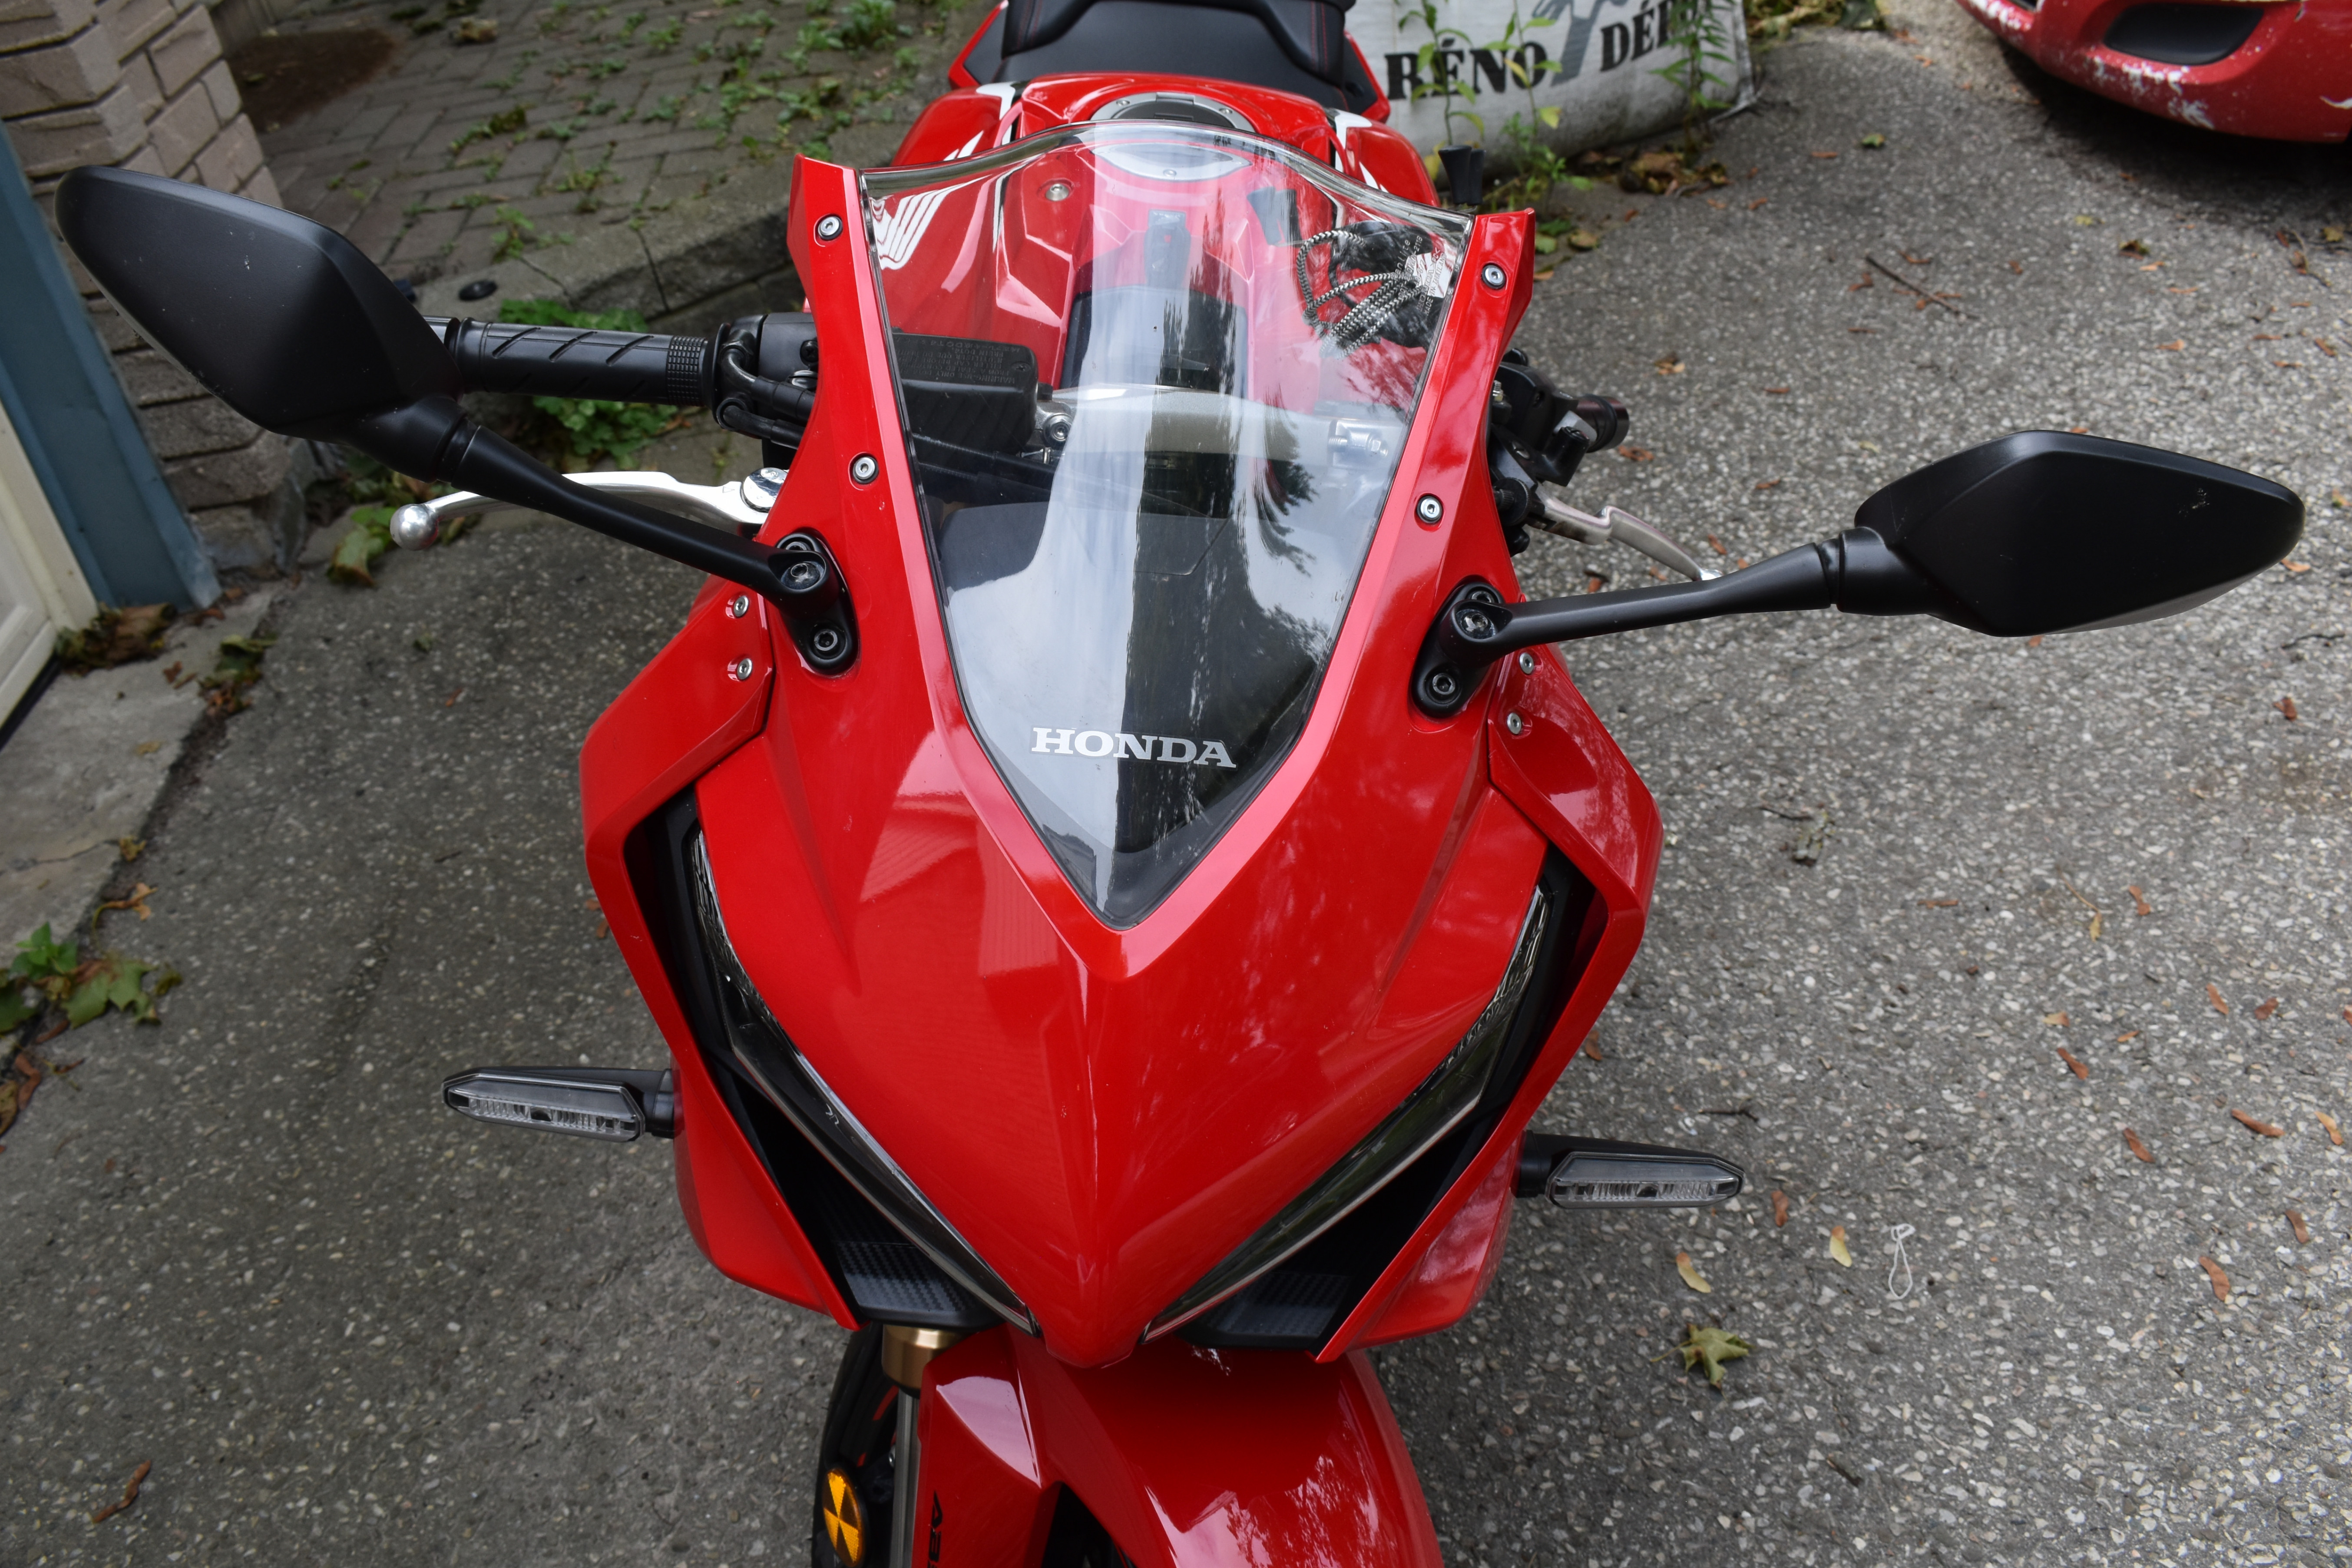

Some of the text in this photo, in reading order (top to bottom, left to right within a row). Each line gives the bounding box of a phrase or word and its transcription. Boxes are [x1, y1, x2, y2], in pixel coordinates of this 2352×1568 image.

[1384, 37, 1548, 100] RÉNO
[1423, 252, 1446, 316] MADE IN THAILAND
[1031, 727, 1237, 768] HONDA
[926, 1490, 943, 1568] AB
